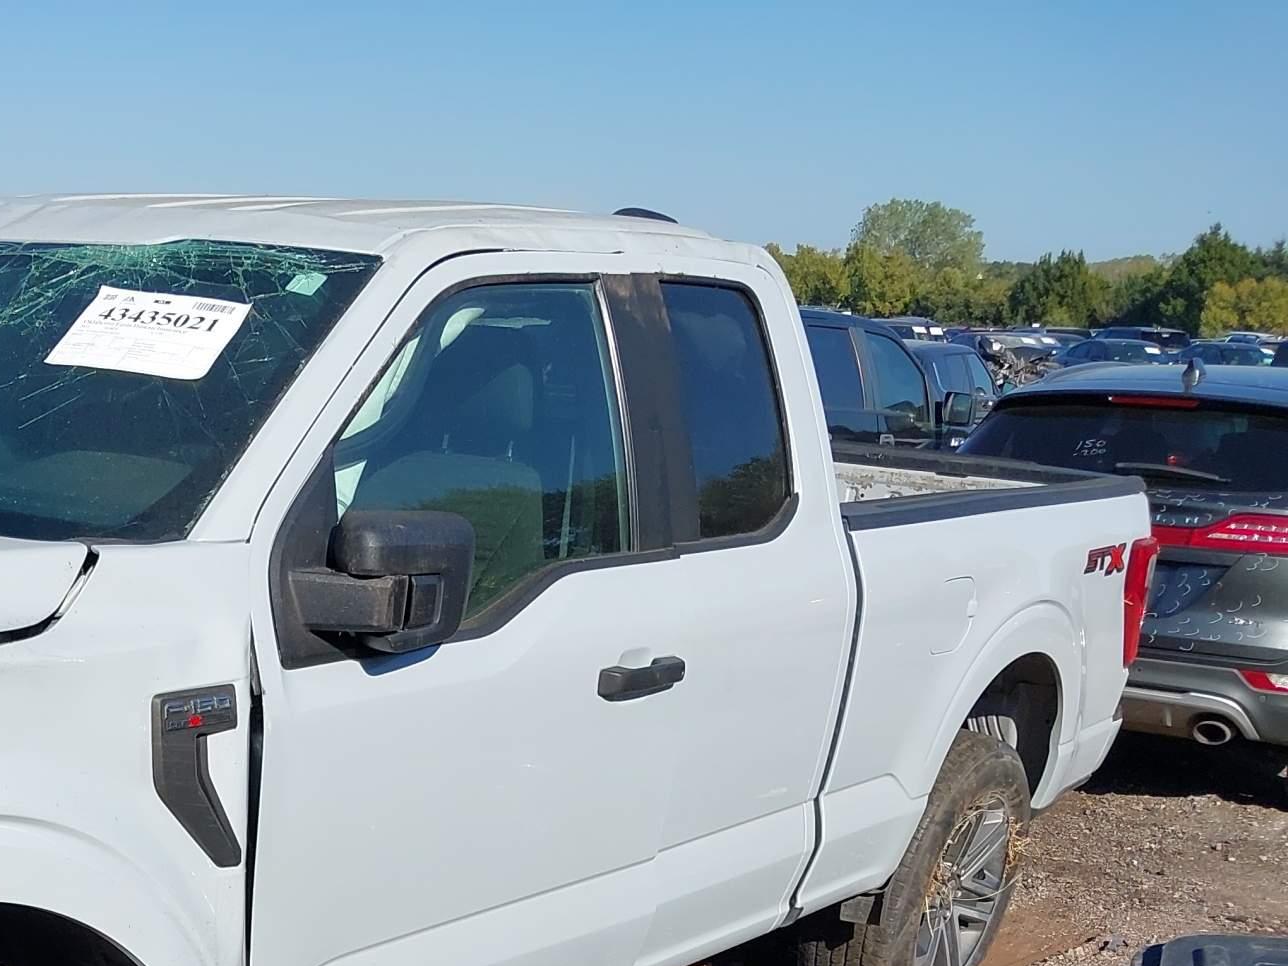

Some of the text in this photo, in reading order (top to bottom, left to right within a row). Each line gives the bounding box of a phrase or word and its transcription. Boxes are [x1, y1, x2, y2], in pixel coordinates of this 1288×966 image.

[98, 306, 220, 333] 43435021
[1076, 439, 1107, 450] 150
[1083, 542, 1127, 577] STX
[164, 696, 232, 719] F-150
